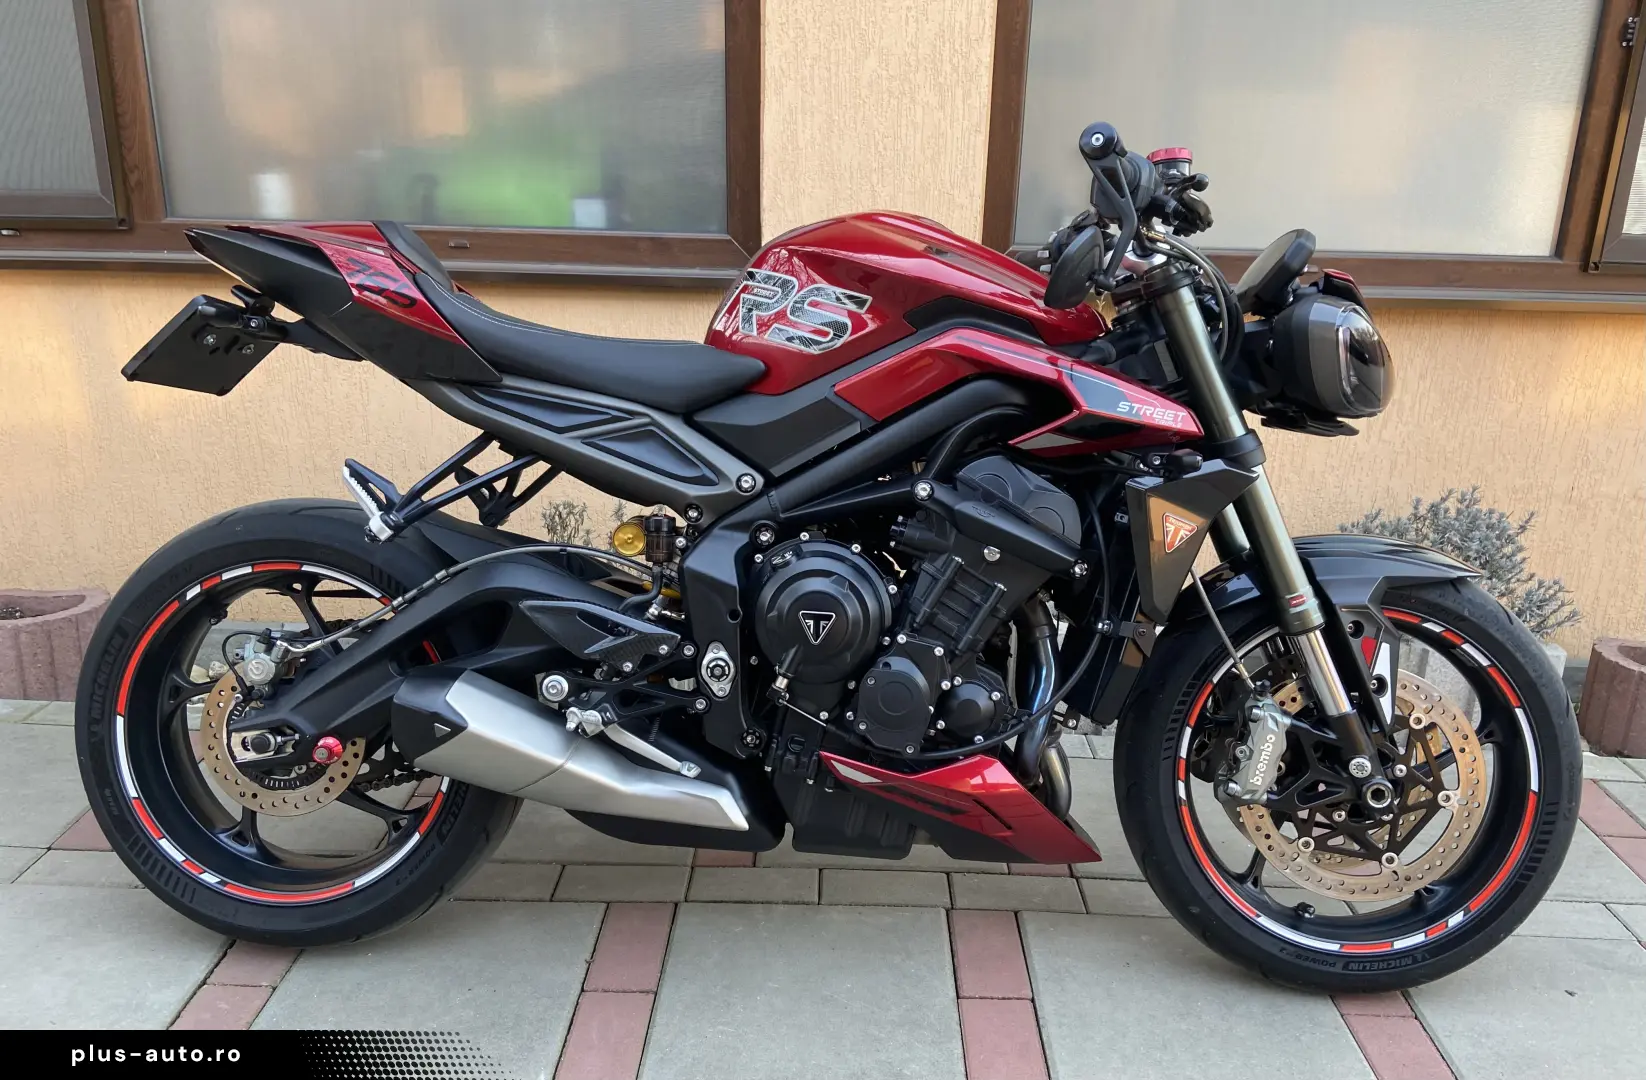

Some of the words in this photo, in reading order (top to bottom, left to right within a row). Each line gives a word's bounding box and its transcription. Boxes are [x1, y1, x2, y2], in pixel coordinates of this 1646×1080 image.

[1117, 401, 1187, 422] STREET
[1154, 418, 1182, 428] TRIPLE
[90, 632, 123, 720] MICHELIN
[1250, 734, 1276, 785] brembo
[1295, 953, 1337, 968] POWER
[1348, 955, 1413, 971] MICHELIN
